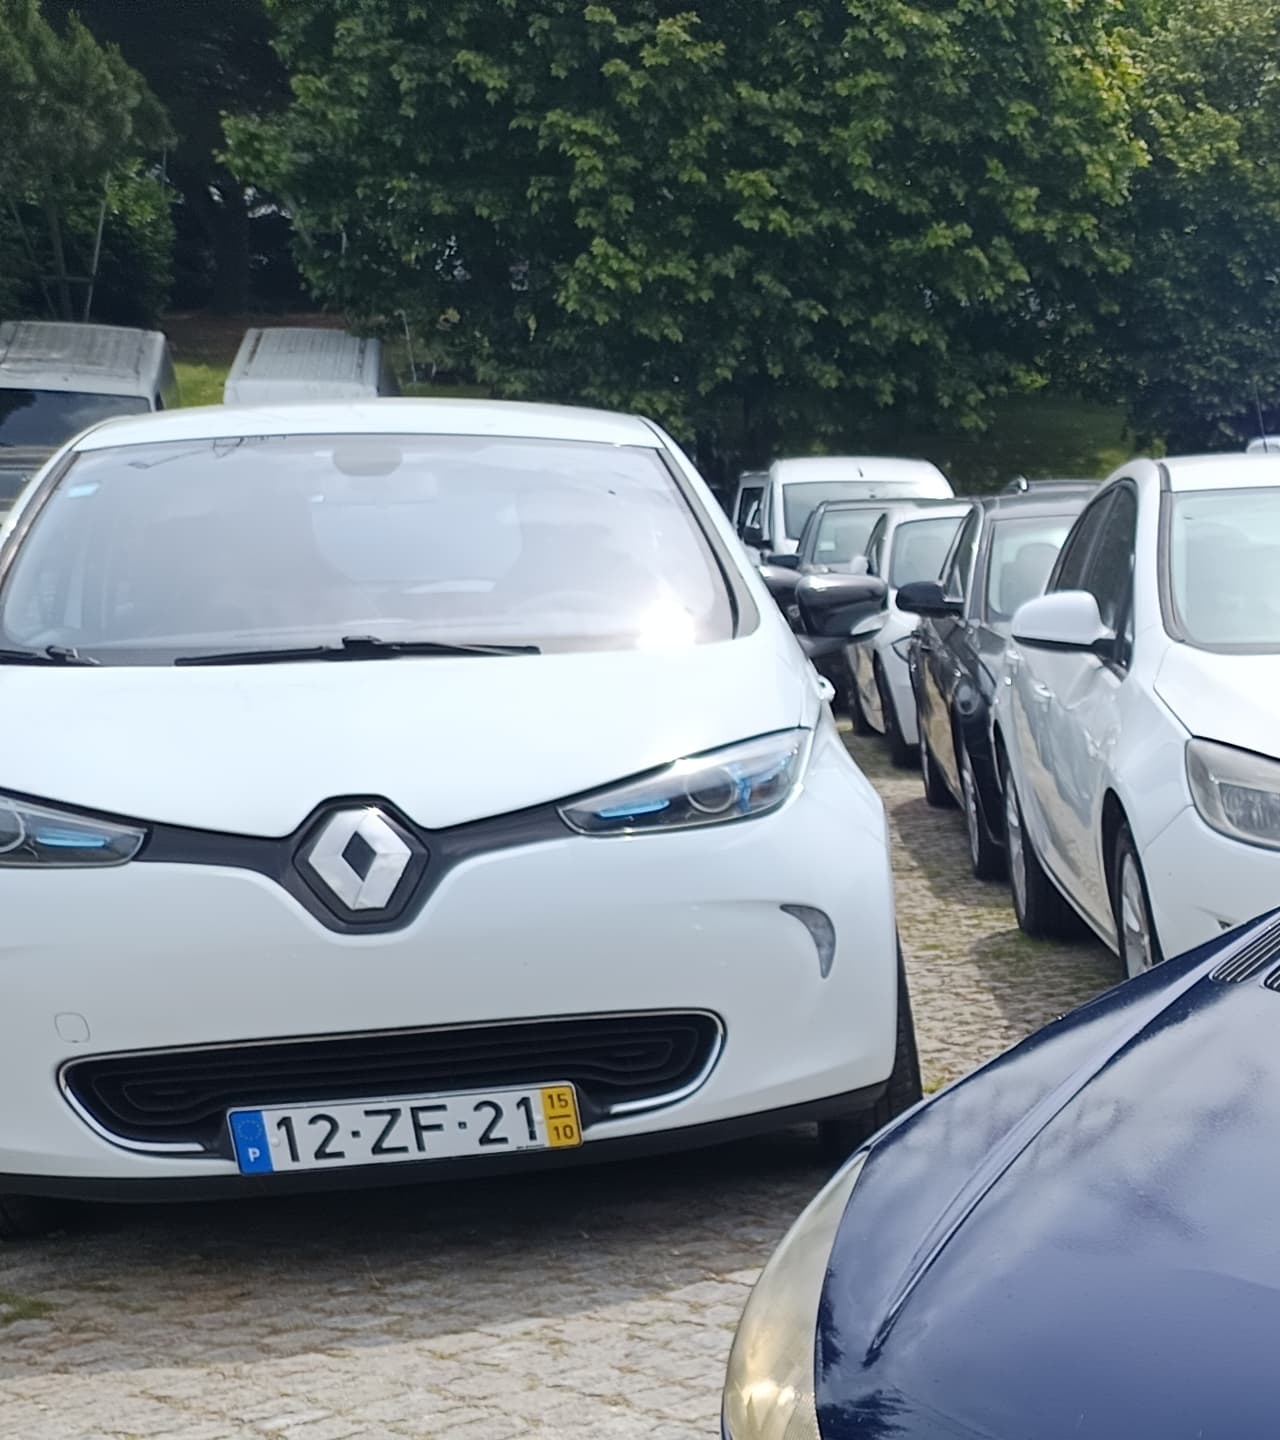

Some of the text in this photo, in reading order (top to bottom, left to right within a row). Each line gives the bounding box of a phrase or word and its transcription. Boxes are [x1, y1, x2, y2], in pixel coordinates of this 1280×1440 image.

[546, 1093, 570, 1111] 15
[552, 1124, 576, 1142] 10
[247, 1147, 261, 1163] P
